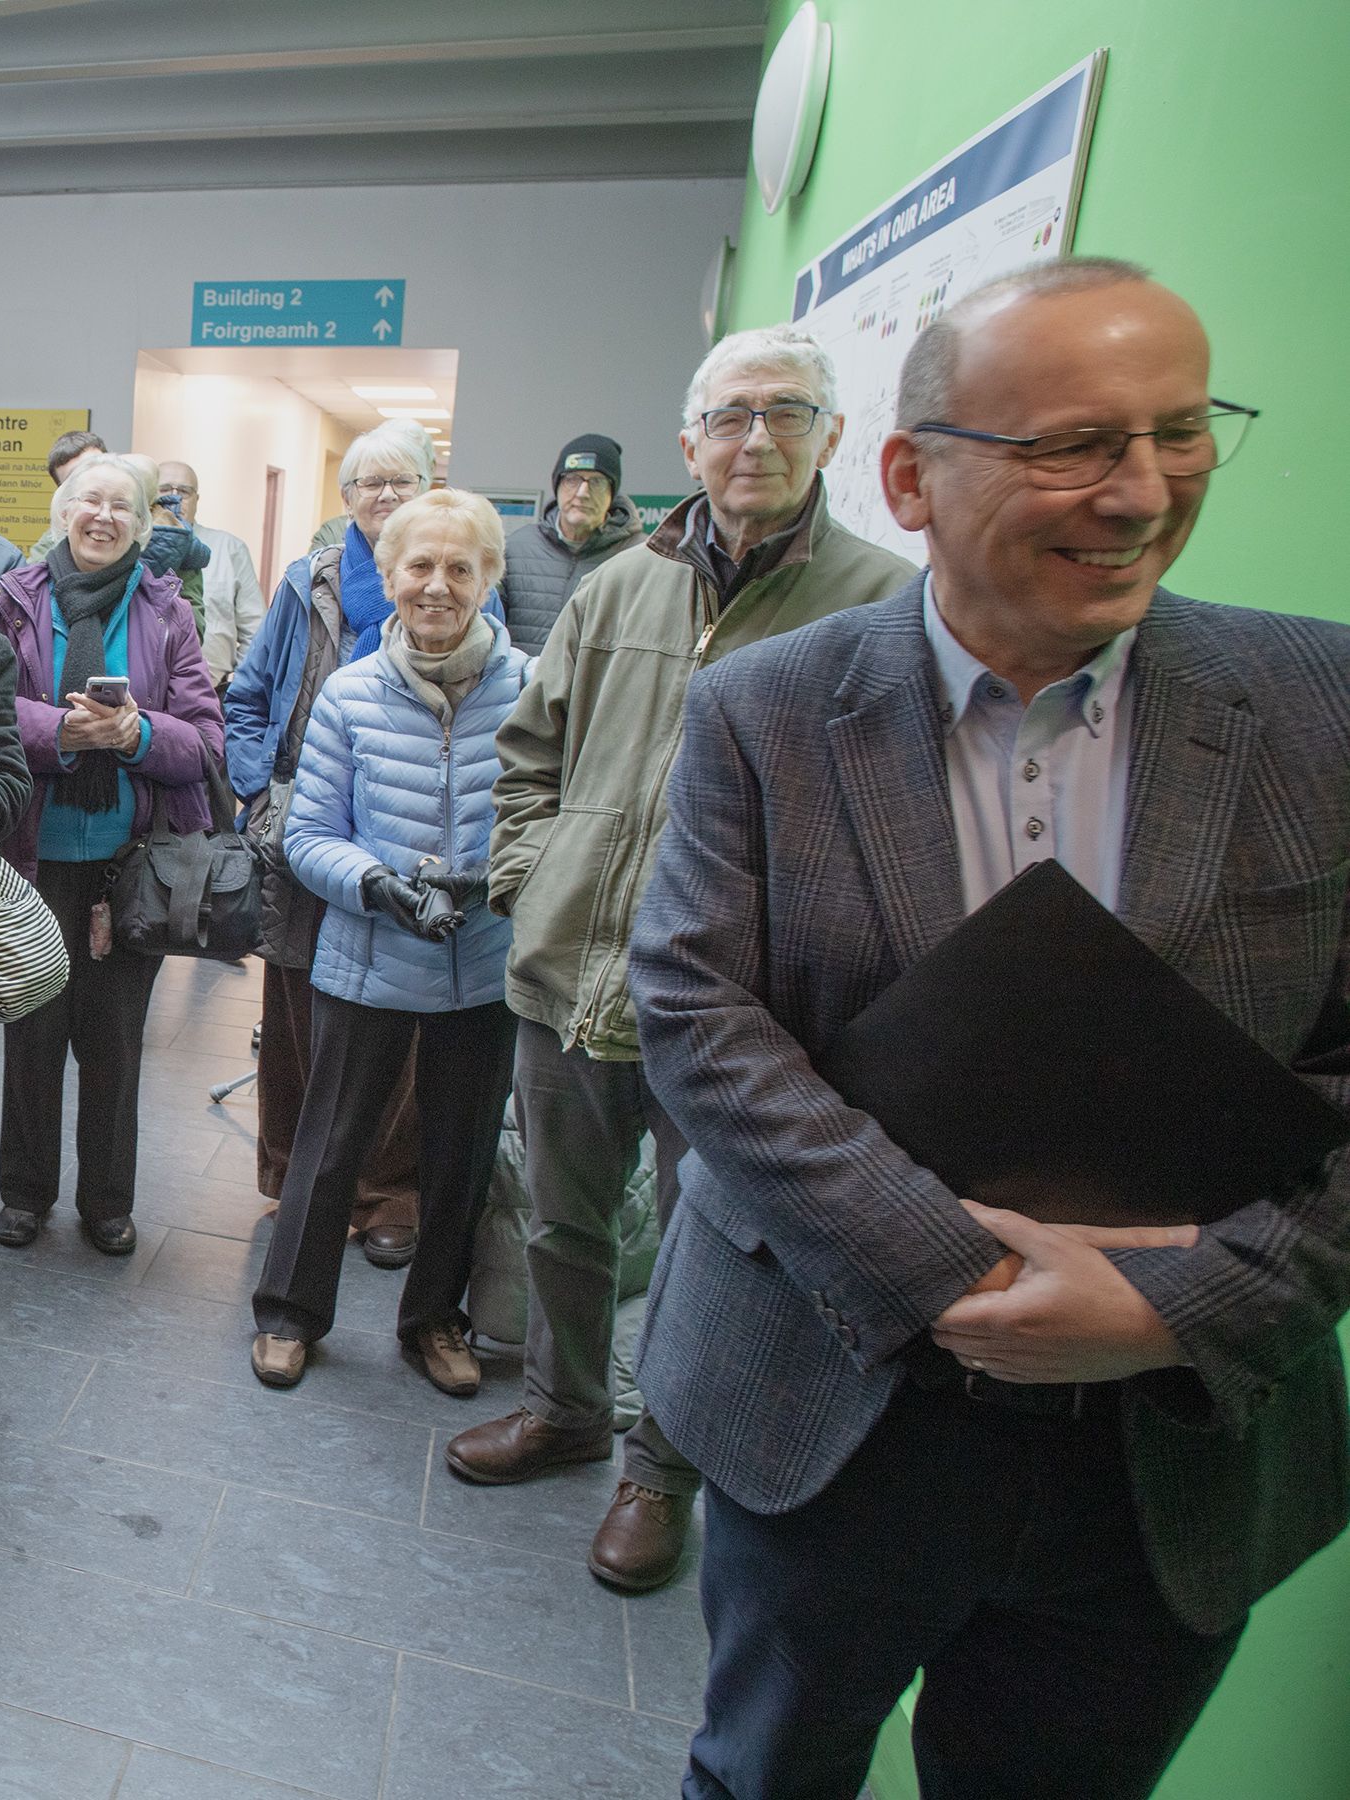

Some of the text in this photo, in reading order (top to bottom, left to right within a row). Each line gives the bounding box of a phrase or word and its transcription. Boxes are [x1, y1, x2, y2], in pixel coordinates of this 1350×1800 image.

[841, 232, 877, 277] WHAT'S
[877, 221, 891, 253] IN
[891, 203, 918, 242] OUR
[917, 177, 955, 226] AREA
[202, 288, 303, 310] Building 2
[201, 320, 337, 342] Foirgneamh 2
